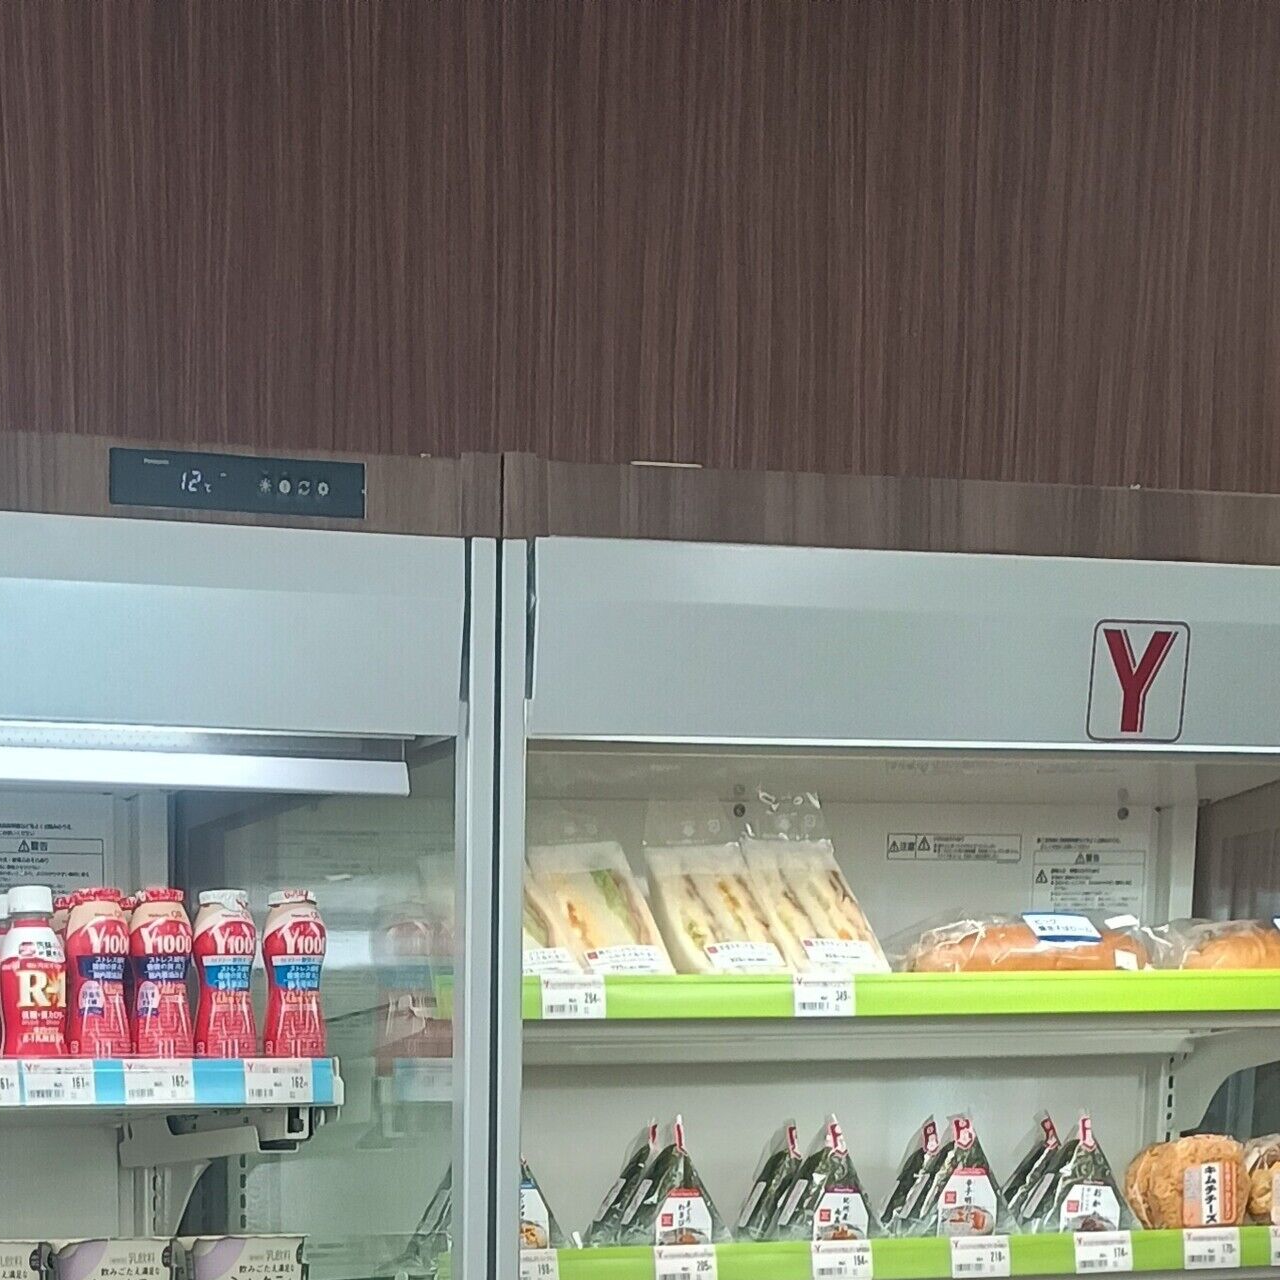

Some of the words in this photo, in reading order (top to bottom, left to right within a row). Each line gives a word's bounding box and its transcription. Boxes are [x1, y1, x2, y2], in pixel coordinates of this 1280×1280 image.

[1103, 629, 1179, 732] Y
[1204, 1165, 1219, 1225] キムチチーズ
